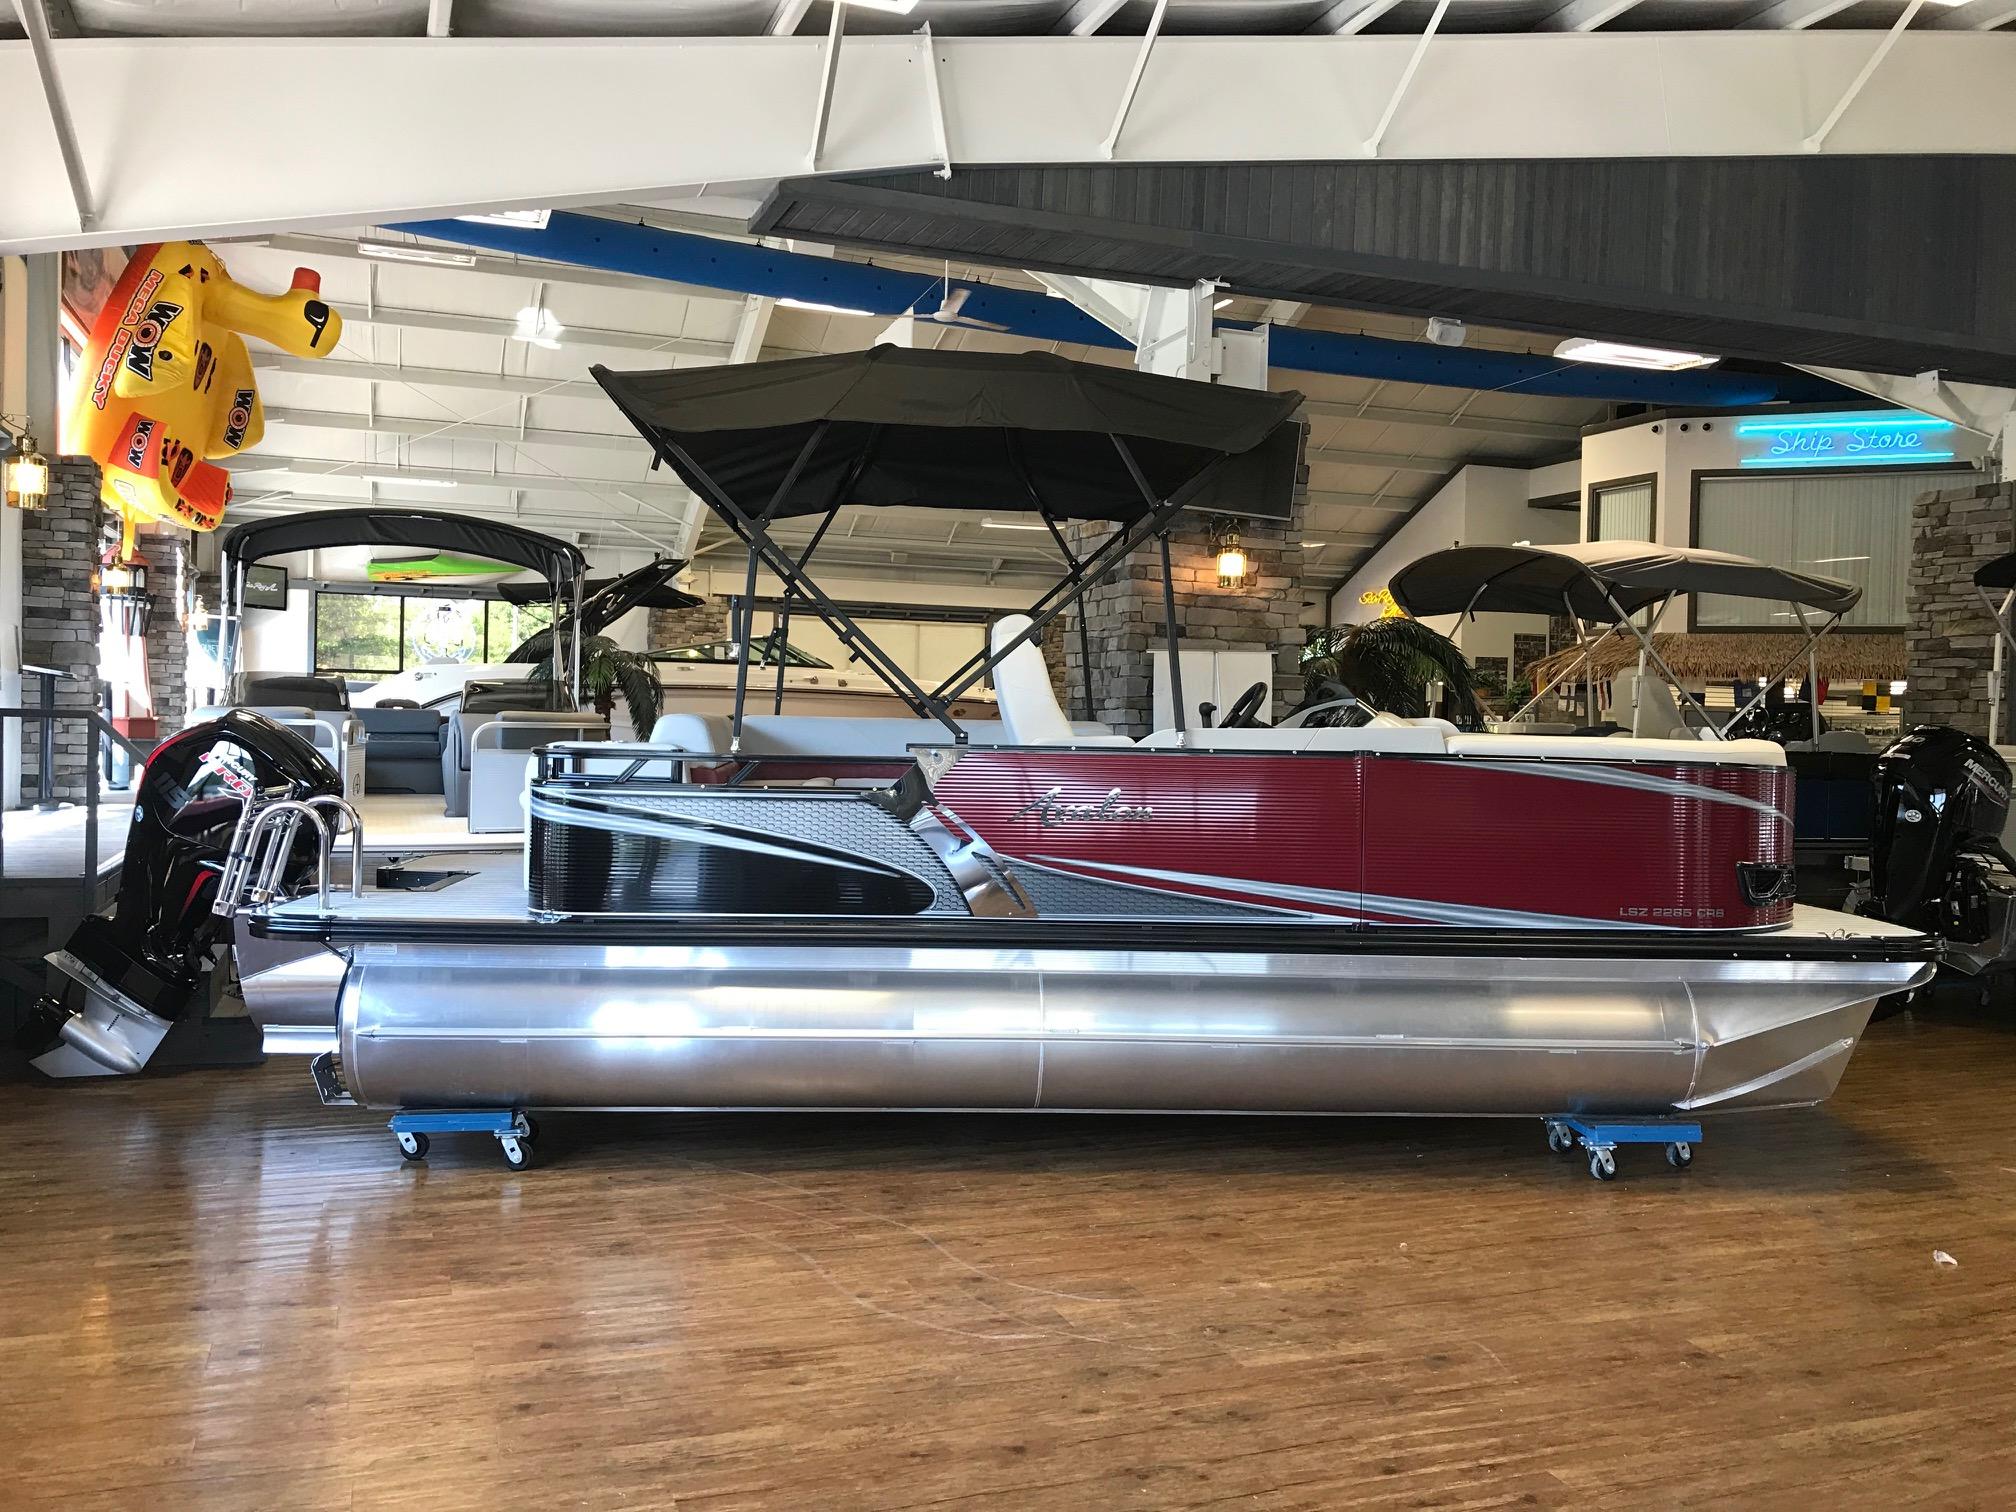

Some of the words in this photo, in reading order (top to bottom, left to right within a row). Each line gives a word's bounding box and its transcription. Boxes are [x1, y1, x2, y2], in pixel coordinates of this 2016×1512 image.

[123, 269, 165, 327] MEGA
[126, 301, 183, 382] WOW
[92, 328, 132, 411] DUCKY
[224, 389, 255, 449] WOW
[1771, 431, 1835, 457] Ship
[1846, 428, 1922, 452] Store
[128, 420, 156, 468] WOW
[198, 752, 254, 798] RO
[1963, 758, 2009, 801] MERCURY
[1007, 786, 1153, 827] Avalon
[1619, 907, 1649, 917] LSZ
[1652, 907, 1693, 918] 2285
